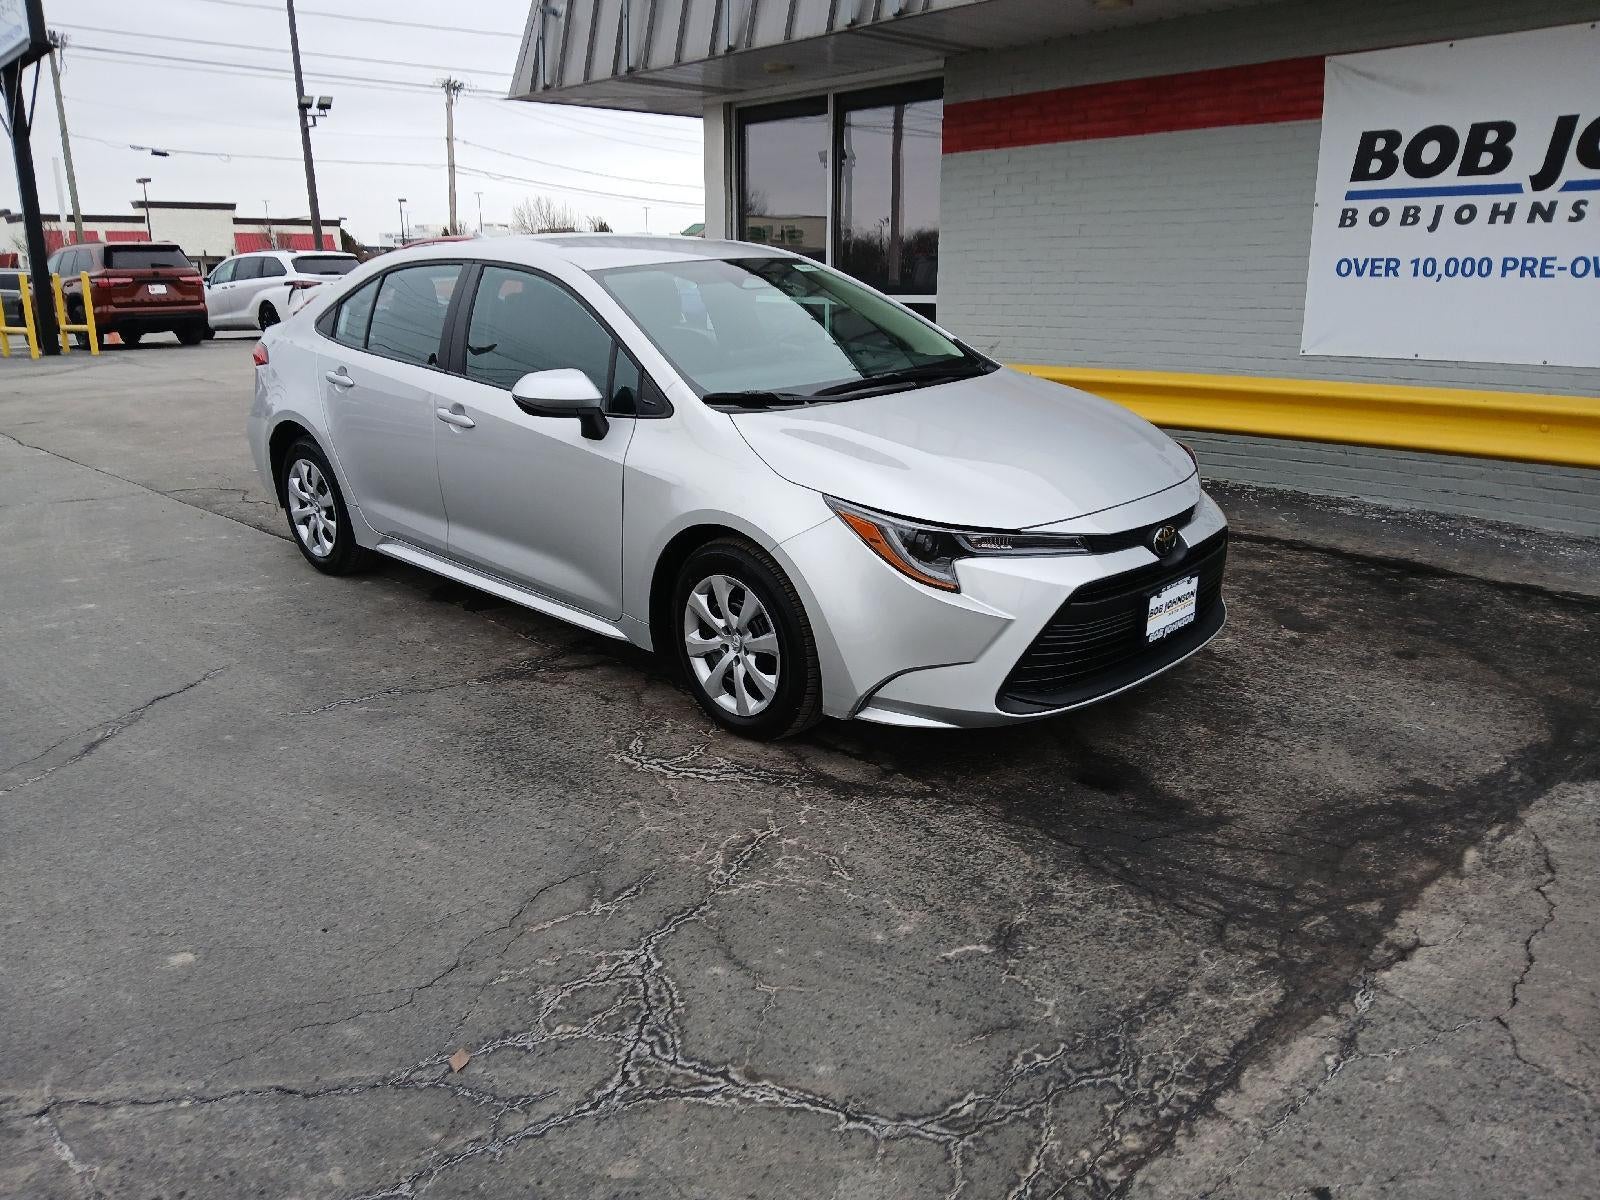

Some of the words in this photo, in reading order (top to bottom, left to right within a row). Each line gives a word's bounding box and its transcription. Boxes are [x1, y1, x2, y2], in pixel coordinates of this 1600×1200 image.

[1349, 120, 1517, 183] BOB
[1335, 257, 1401, 278] OVER
[1410, 256, 1492, 283] 10,000
